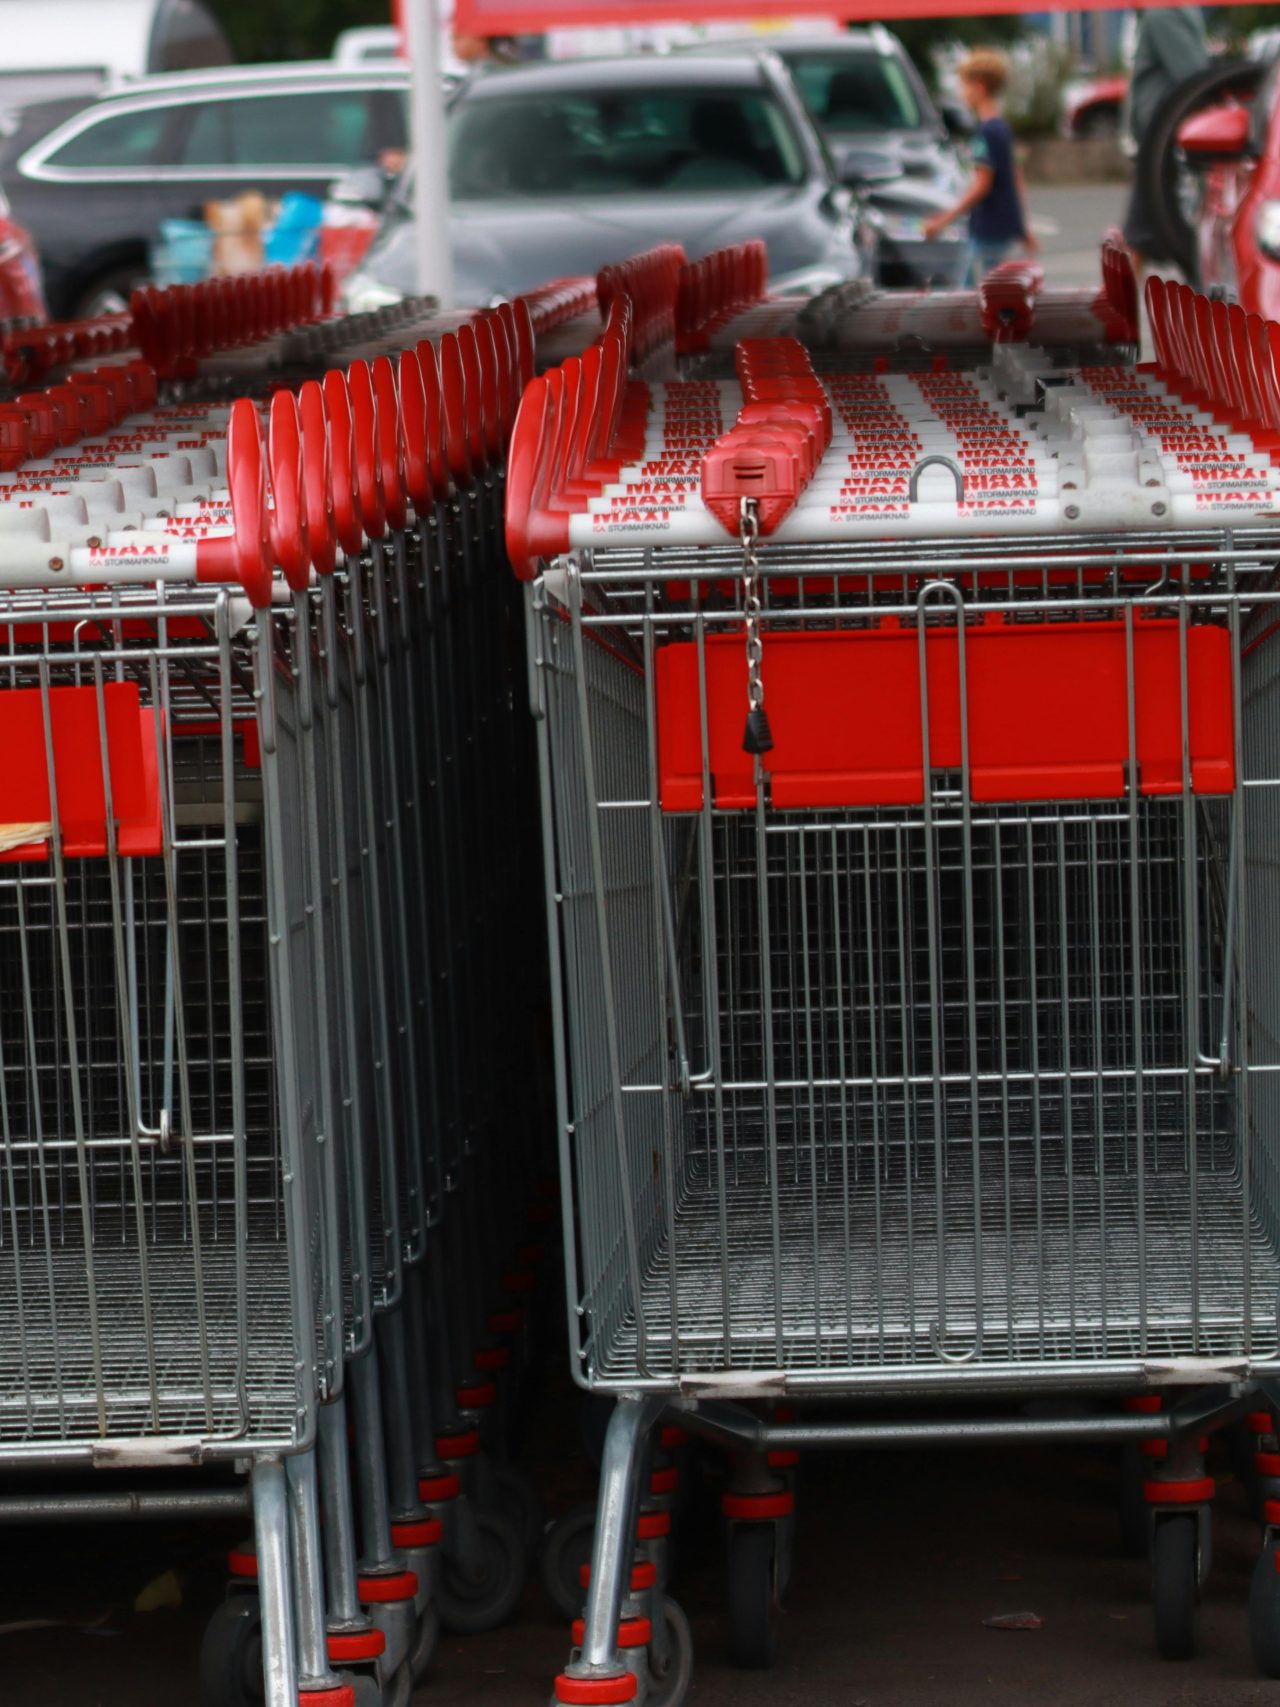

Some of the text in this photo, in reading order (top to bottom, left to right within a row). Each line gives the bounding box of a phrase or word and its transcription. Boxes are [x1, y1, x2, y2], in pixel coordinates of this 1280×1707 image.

[1147, 425, 1208, 434] MAXI
[854, 433, 918, 442] MAXI
[956, 430, 1020, 439] MAXI
[665, 438, 716, 449] MAX
[1162, 442, 1227, 452] MAXI
[848, 452, 916, 462] MAXI
[957, 449, 1025, 458] MAXI
[965, 459, 1035, 467] MAXI
[1177, 454, 1245, 463] MAXI
[16, 469, 80, 479] MAXI
[641, 467, 700, 476] MAX
[844, 477, 907, 486] MAX
[1207, 480, 1268, 489] STORMARKNAD
[626, 483, 697, 494] MAXI
[840, 486, 905, 496] MAX
[977, 490, 1039, 499] STORMARKNAD
[1196, 492, 1272, 501] MAXI
[611, 495, 685, 506] MAXI
[957, 499, 1036, 509] MAXI
[830, 504, 909, 514] MAXI
[1211, 502, 1273, 511] STORMARKNAD
[973, 508, 1037, 517] STORMARKNAD
[167, 515, 229, 526] MAX
[593, 511, 669, 524] MAXI
[846, 513, 910, 522] STORMARKNAD
[608, 522, 670, 532] STORMARKNAD
[90, 545, 169, 556] MAXI
[104, 557, 169, 566] STORMARKNAD
